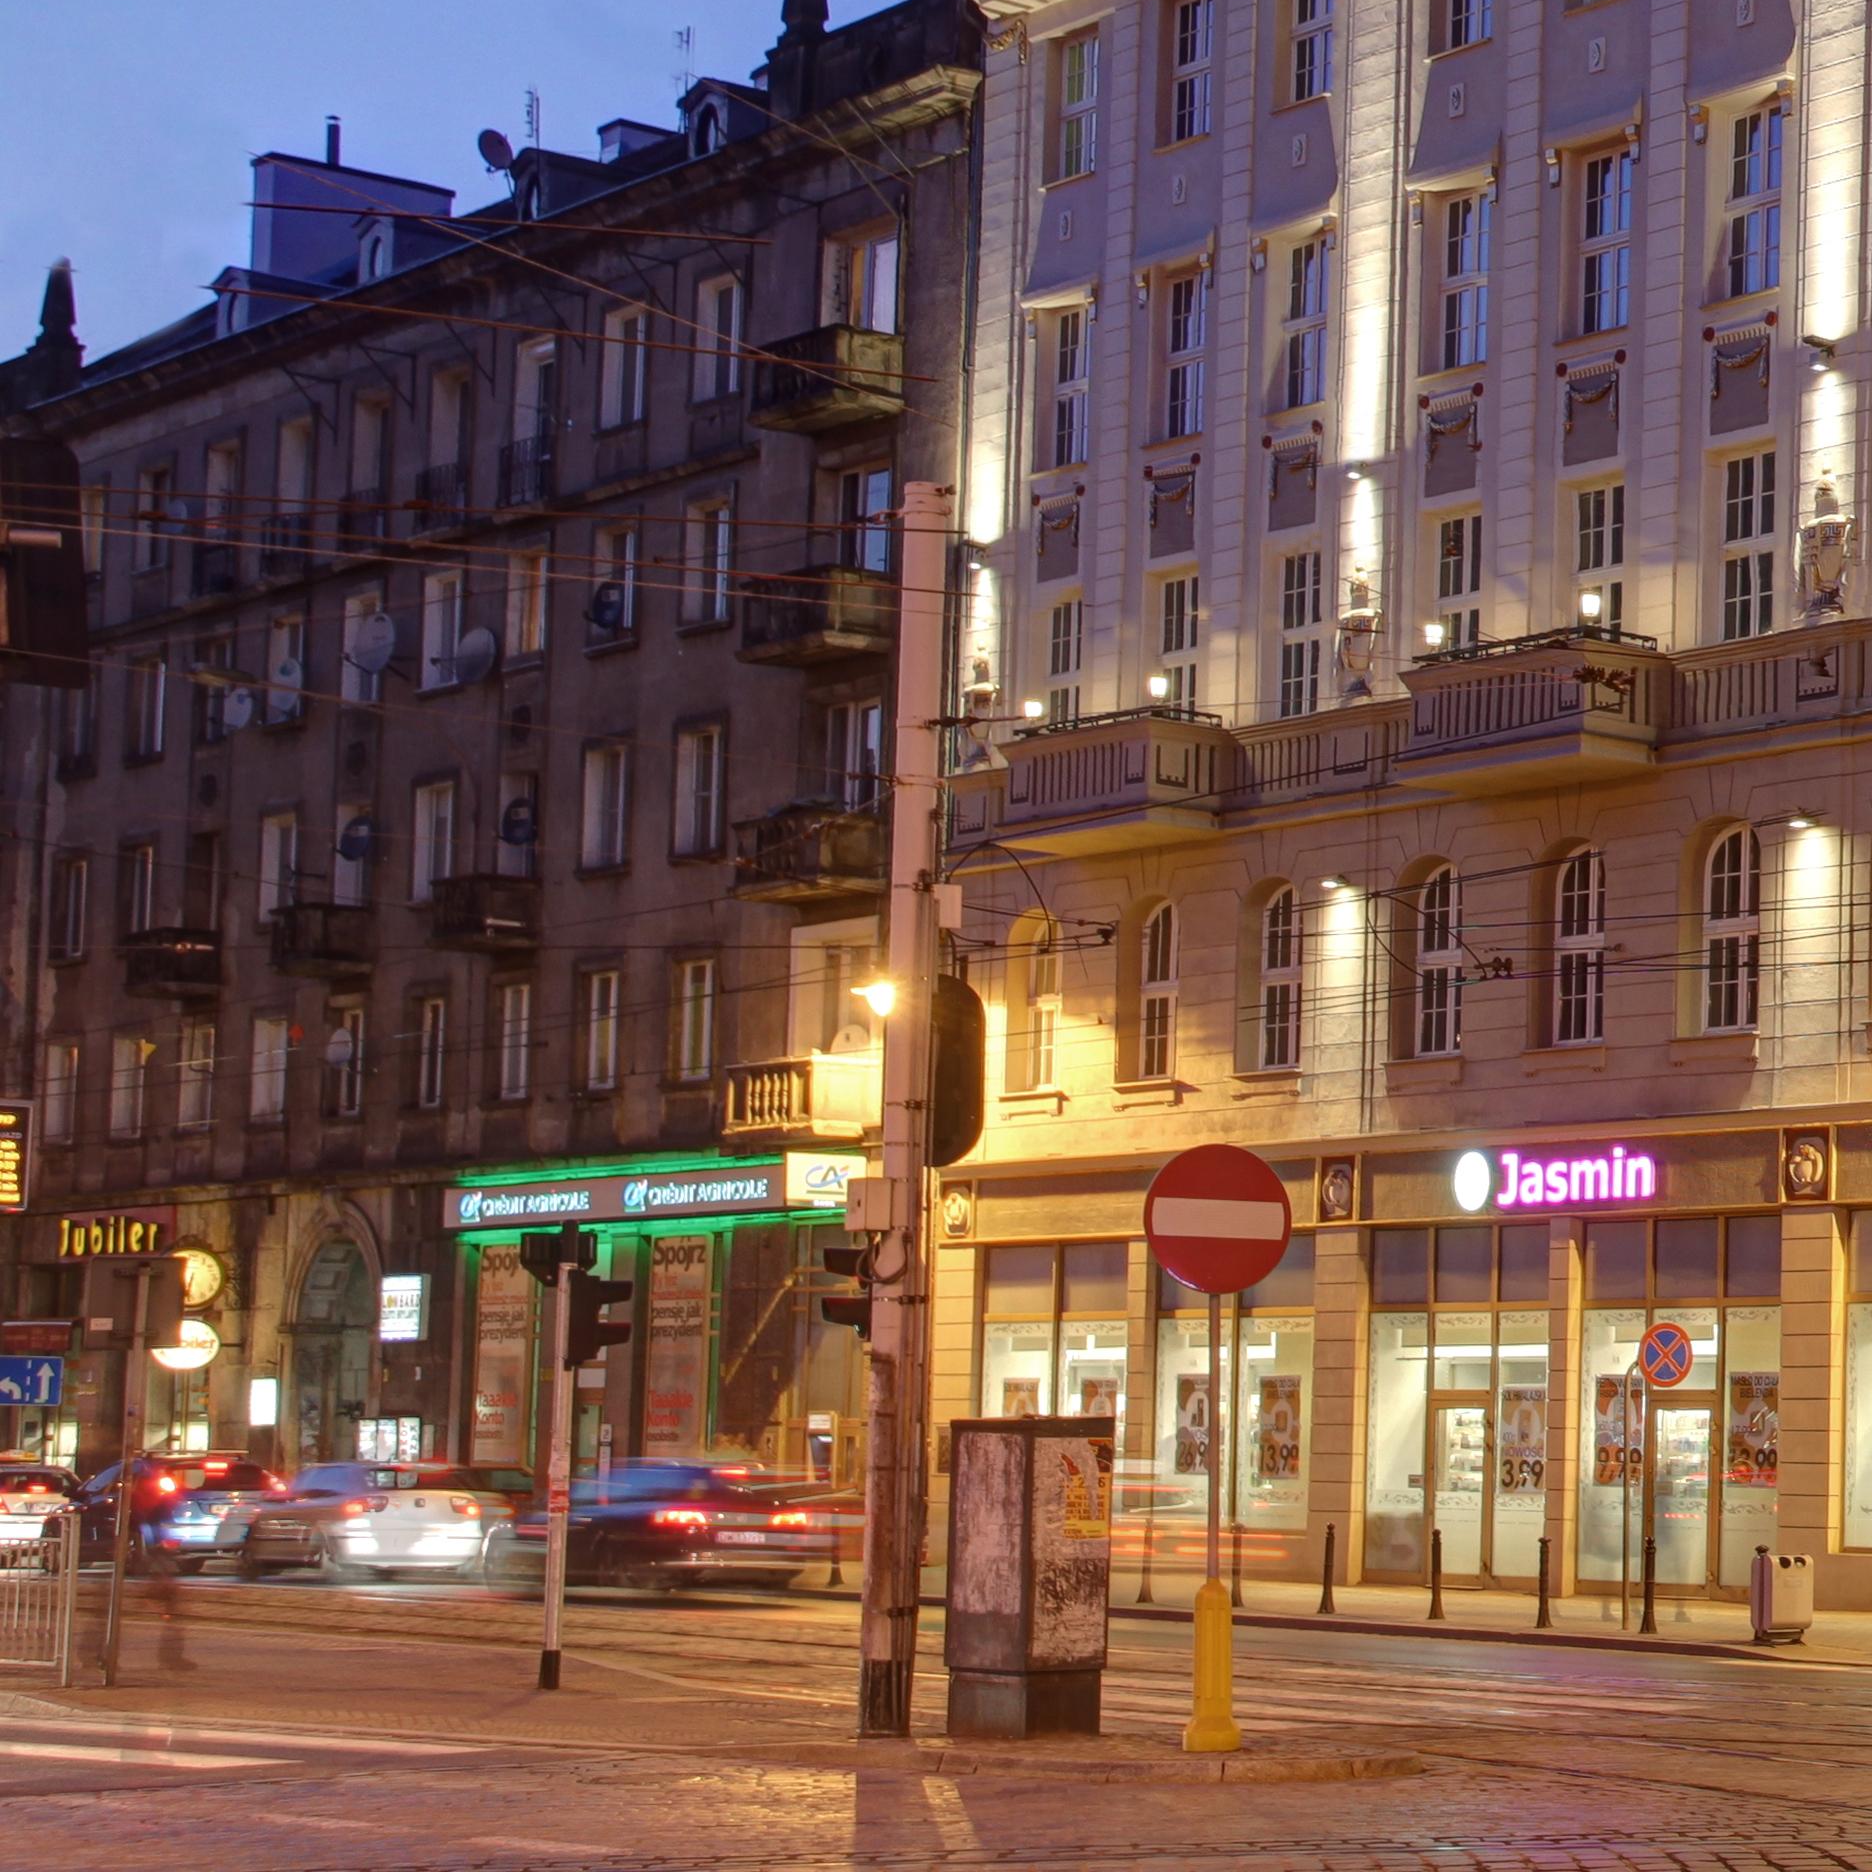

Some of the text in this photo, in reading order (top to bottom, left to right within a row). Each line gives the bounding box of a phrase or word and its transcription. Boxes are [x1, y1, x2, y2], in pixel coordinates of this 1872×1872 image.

[697, 1178, 768, 1201] AGRICOLE
[1496, 1146, 1655, 1206] Jasmin
[526, 1191, 590, 1213] AGRICOLE
[60, 1215, 158, 1259] Jubiler
[1260, 1444, 1299, 1474] 13,99
[1502, 1459, 1544, 1489] 3,99
